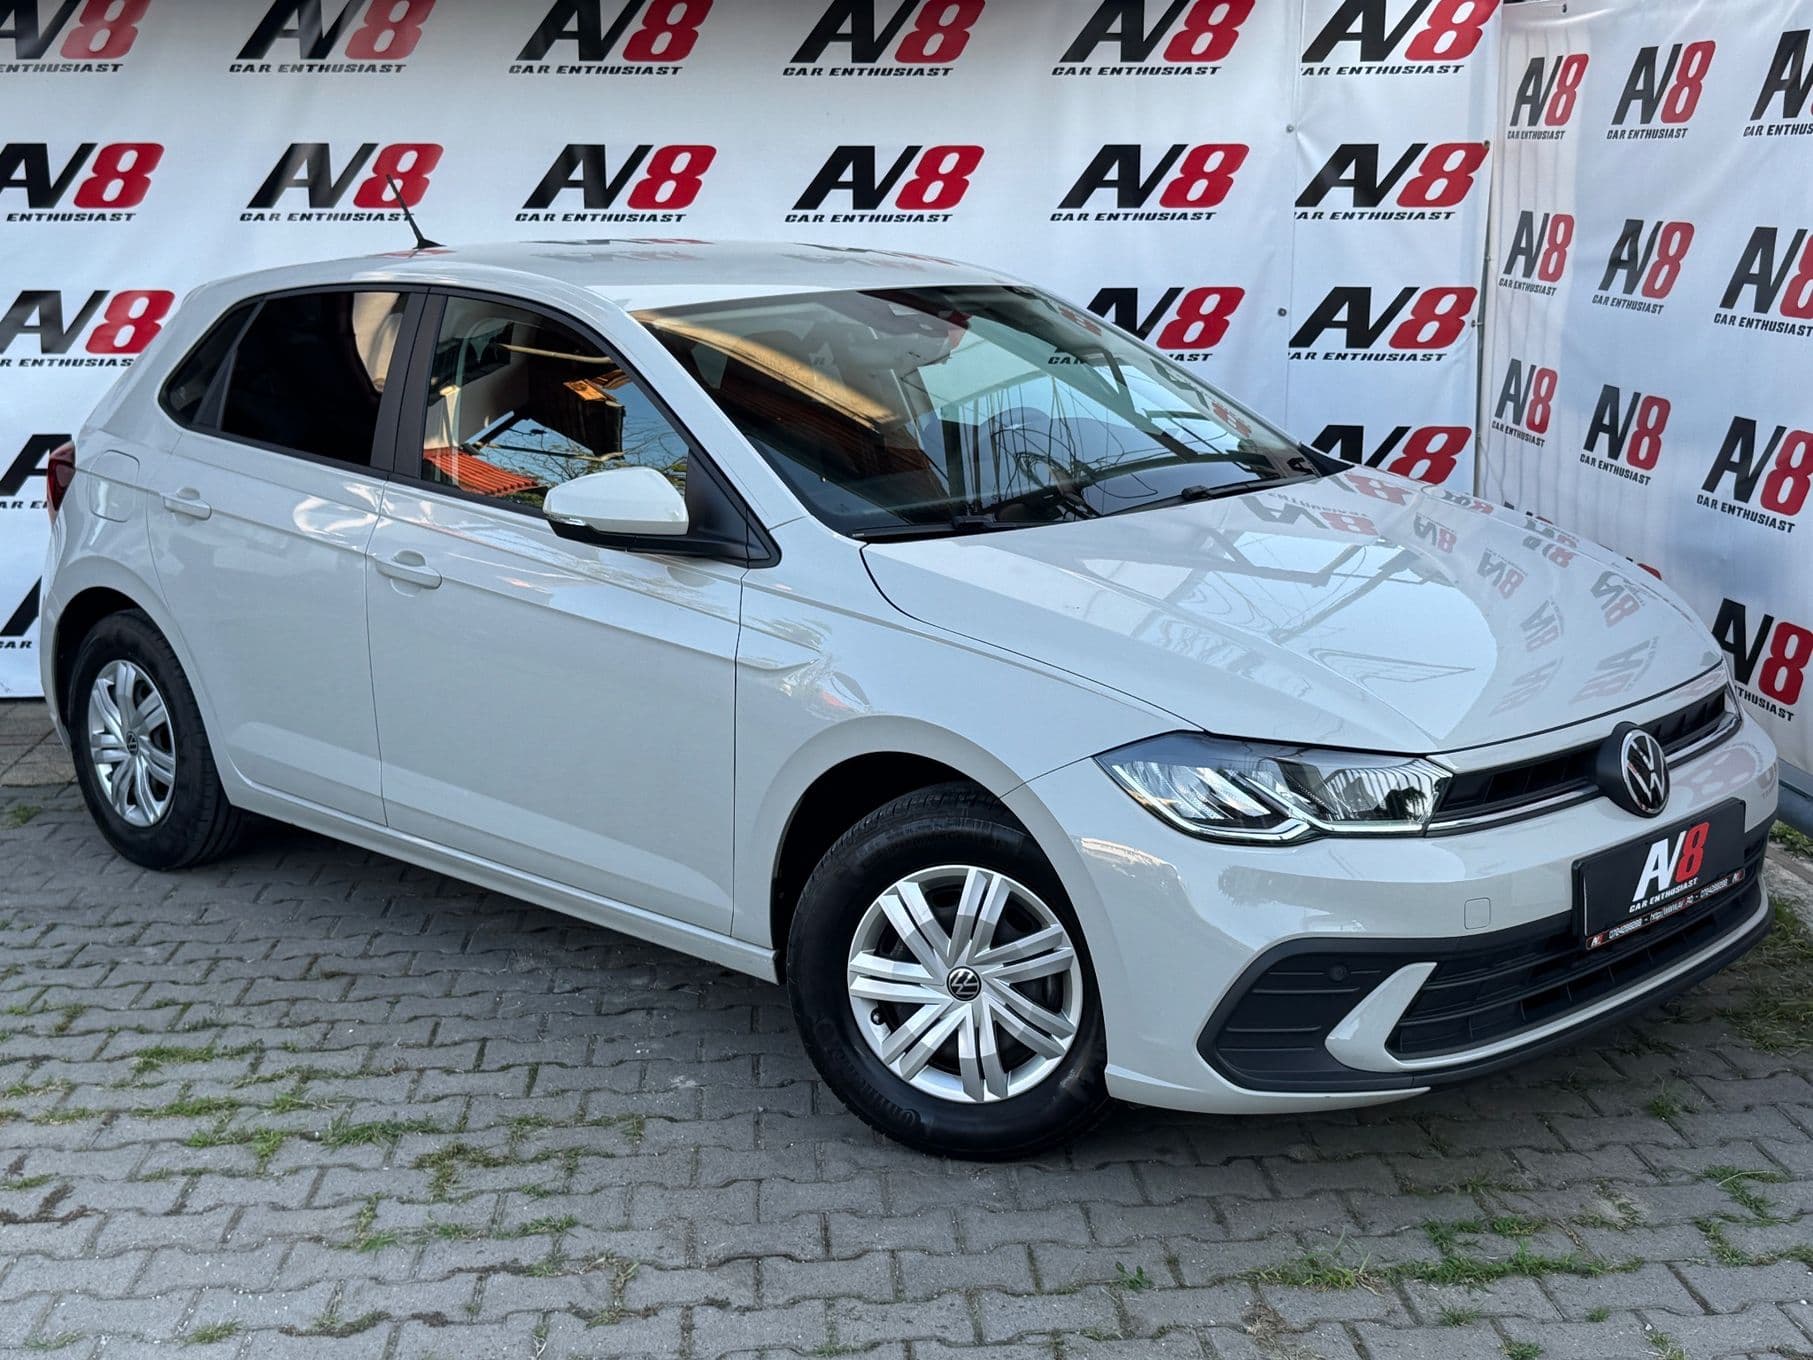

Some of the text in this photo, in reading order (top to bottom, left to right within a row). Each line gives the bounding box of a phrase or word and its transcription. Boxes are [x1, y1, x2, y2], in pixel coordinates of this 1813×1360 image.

[236, 0, 436, 59] AV8
[515, 0, 713, 62] AV8
[789, 0, 986, 64] AV8
[1059, 0, 1256, 62] AV8
[1301, 0, 1500, 63] AV8
[229, 64, 407, 73] CAR ENTHUSIAST
[508, 65, 683, 75] CAR ENTHUSIAST
[783, 67, 954, 76] CAR ENTHUSIAST
[1052, 67, 1221, 75] CAR ENTHUSIAST
[1300, 65, 1464, 76] AR ENTHUSIAST
[1611, 40, 1717, 125] AV8
[1749, 29, 1813, 120] AV
[1510, 54, 1589, 126] AV8
[1507, 130, 1566, 139] CAR ENTHUSIAST
[1606, 128, 1688, 140] CAR ENTHUSIAST
[1743, 123, 1813, 137] CAR ENTHUS
[0, 143, 165, 209] AV8
[246, 143, 444, 209] AV8
[522, 144, 717, 210] AV8
[792, 145, 985, 210] AV8
[1057, 143, 1249, 208] AV8
[1295, 143, 1490, 208] AV8
[7, 213, 136, 221] ENTHUSIAST
[240, 213, 415, 221] CAR ENTHUSIAST
[515, 214, 687, 222] CAR ENTHUSIAST
[784, 214, 953, 222] CAR ENTHUSIAST
[1050, 212, 1216, 221] CAR ENTHUSIAST
[1293, 211, 1455, 221] AR ENTHUSIAST
[1503, 210, 1575, 283] AV8
[1598, 219, 1695, 299] AV8
[1498, 278, 1557, 297] CAR ENTHUSIAST
[1592, 294, 1664, 315] CAR ENTHUSIAST
[0, 290, 175, 354] AV8
[1288, 286, 1477, 349] AV8
[1714, 312, 1813, 337] CAR ENTHUSIAST
[18, 358, 135, 367] ENTHUSIAS
[1287, 351, 1447, 362] AR ENTHUSIAST
[1494, 358, 1558, 434] AV8
[1504, 423, 1545, 448] ENTHUSIAST
[1583, 384, 1671, 471] AV8
[1580, 453, 1651, 486] CAR ENTHUSIAST
[1701, 415, 1813, 517] AV8
[1697, 495, 1796, 534] CAR ENTHUSIAST
[1735, 686, 1795, 722] THUSIAST
[1632, 822, 1710, 902] AV8
[1629, 900, 1649, 913] CAR
[1649, 876, 1698, 905] ENTHUSIAST
